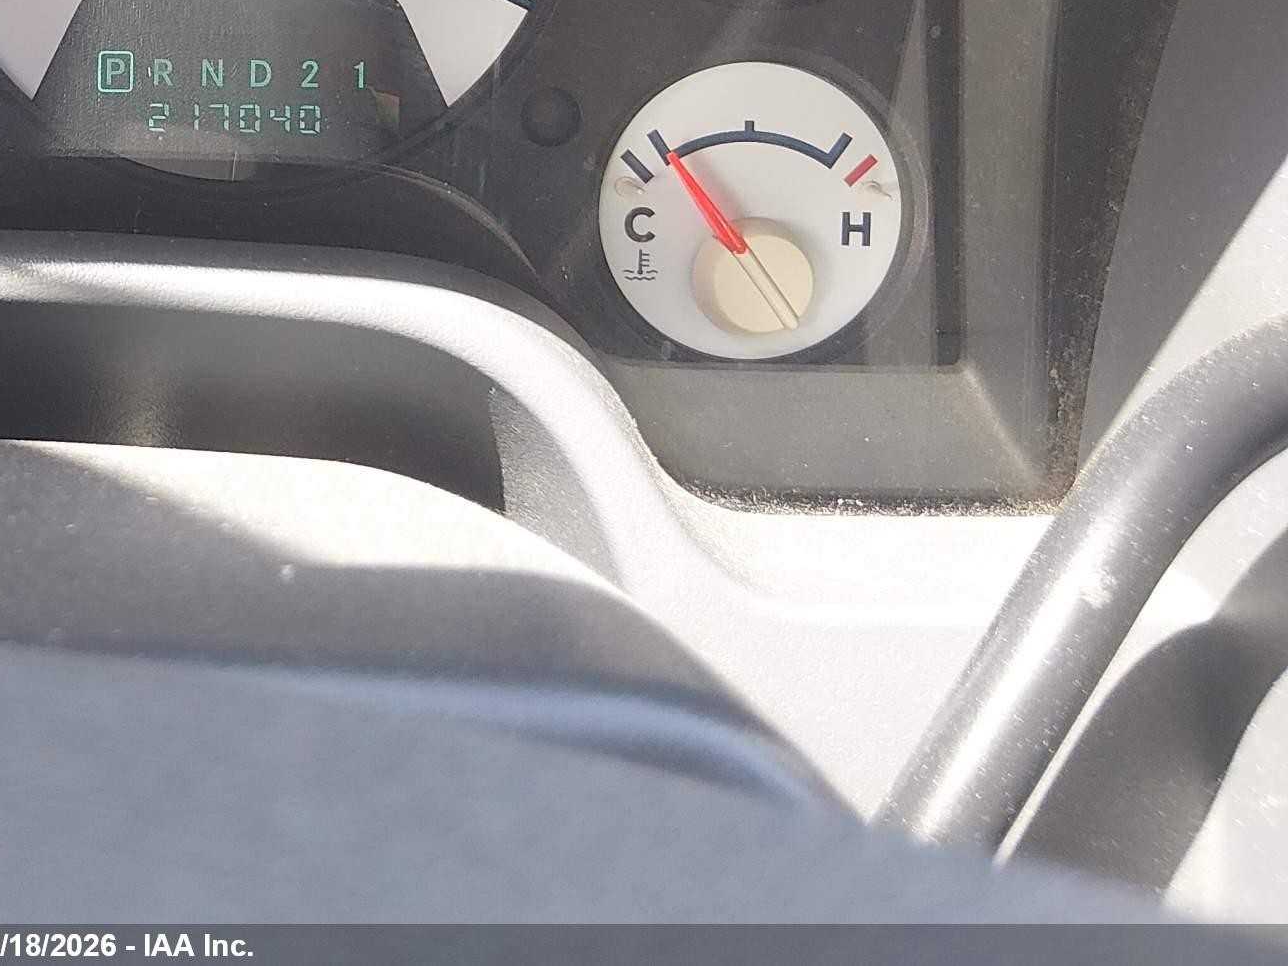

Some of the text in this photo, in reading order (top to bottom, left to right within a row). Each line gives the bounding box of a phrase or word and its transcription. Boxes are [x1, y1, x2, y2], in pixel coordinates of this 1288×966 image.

[105, 57, 367, 89] P R N D 2 1
[148, 102, 321, 134] 217040
[625, 207, 655, 242] C
[842, 212, 871, 246] H
